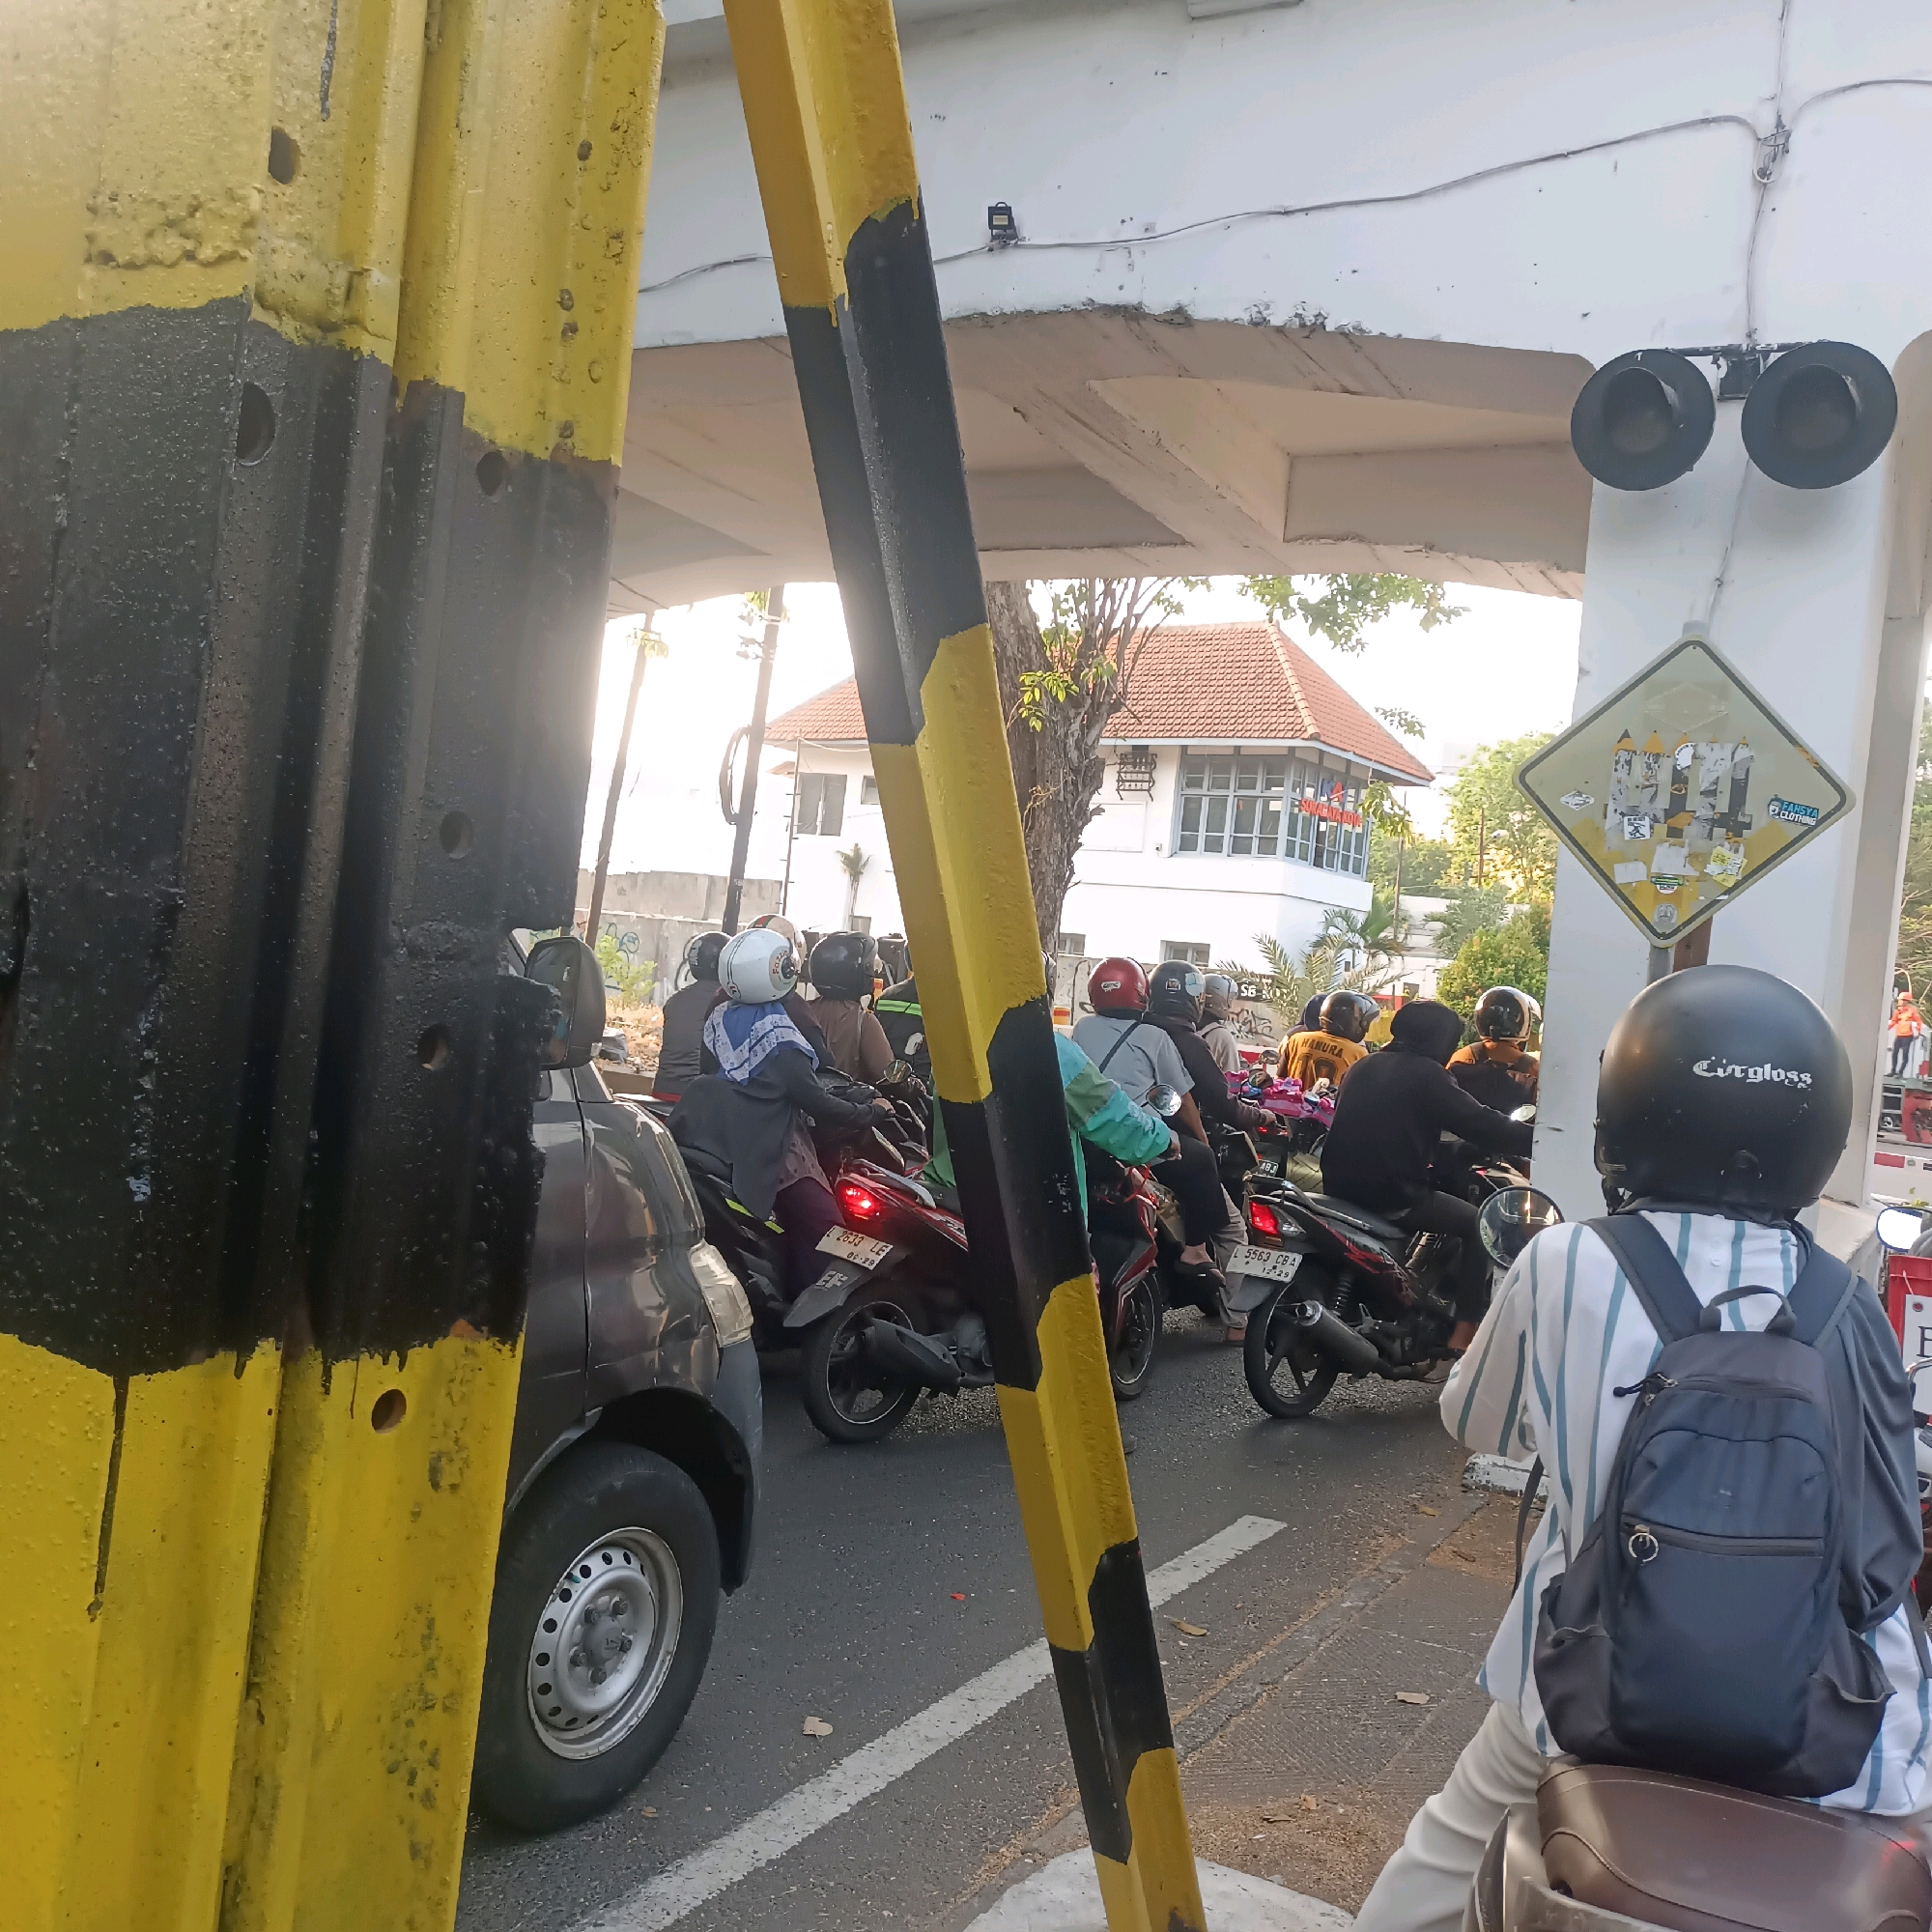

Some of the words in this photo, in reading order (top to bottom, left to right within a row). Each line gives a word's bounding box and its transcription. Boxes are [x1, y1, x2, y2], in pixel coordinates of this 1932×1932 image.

[1300, 797, 1342, 823] SURABAYA
[1779, 810, 1817, 826] CLOTHING
[1781, 802, 1818, 818] FAHSYA
[836, 1230, 865, 1247] 2633
[869, 1241, 890, 1257] LE
[1233, 1247, 1239, 1259] L
[1244, 1248, 1271, 1263] 5563
[1275, 1254, 1297, 1266] CBA
